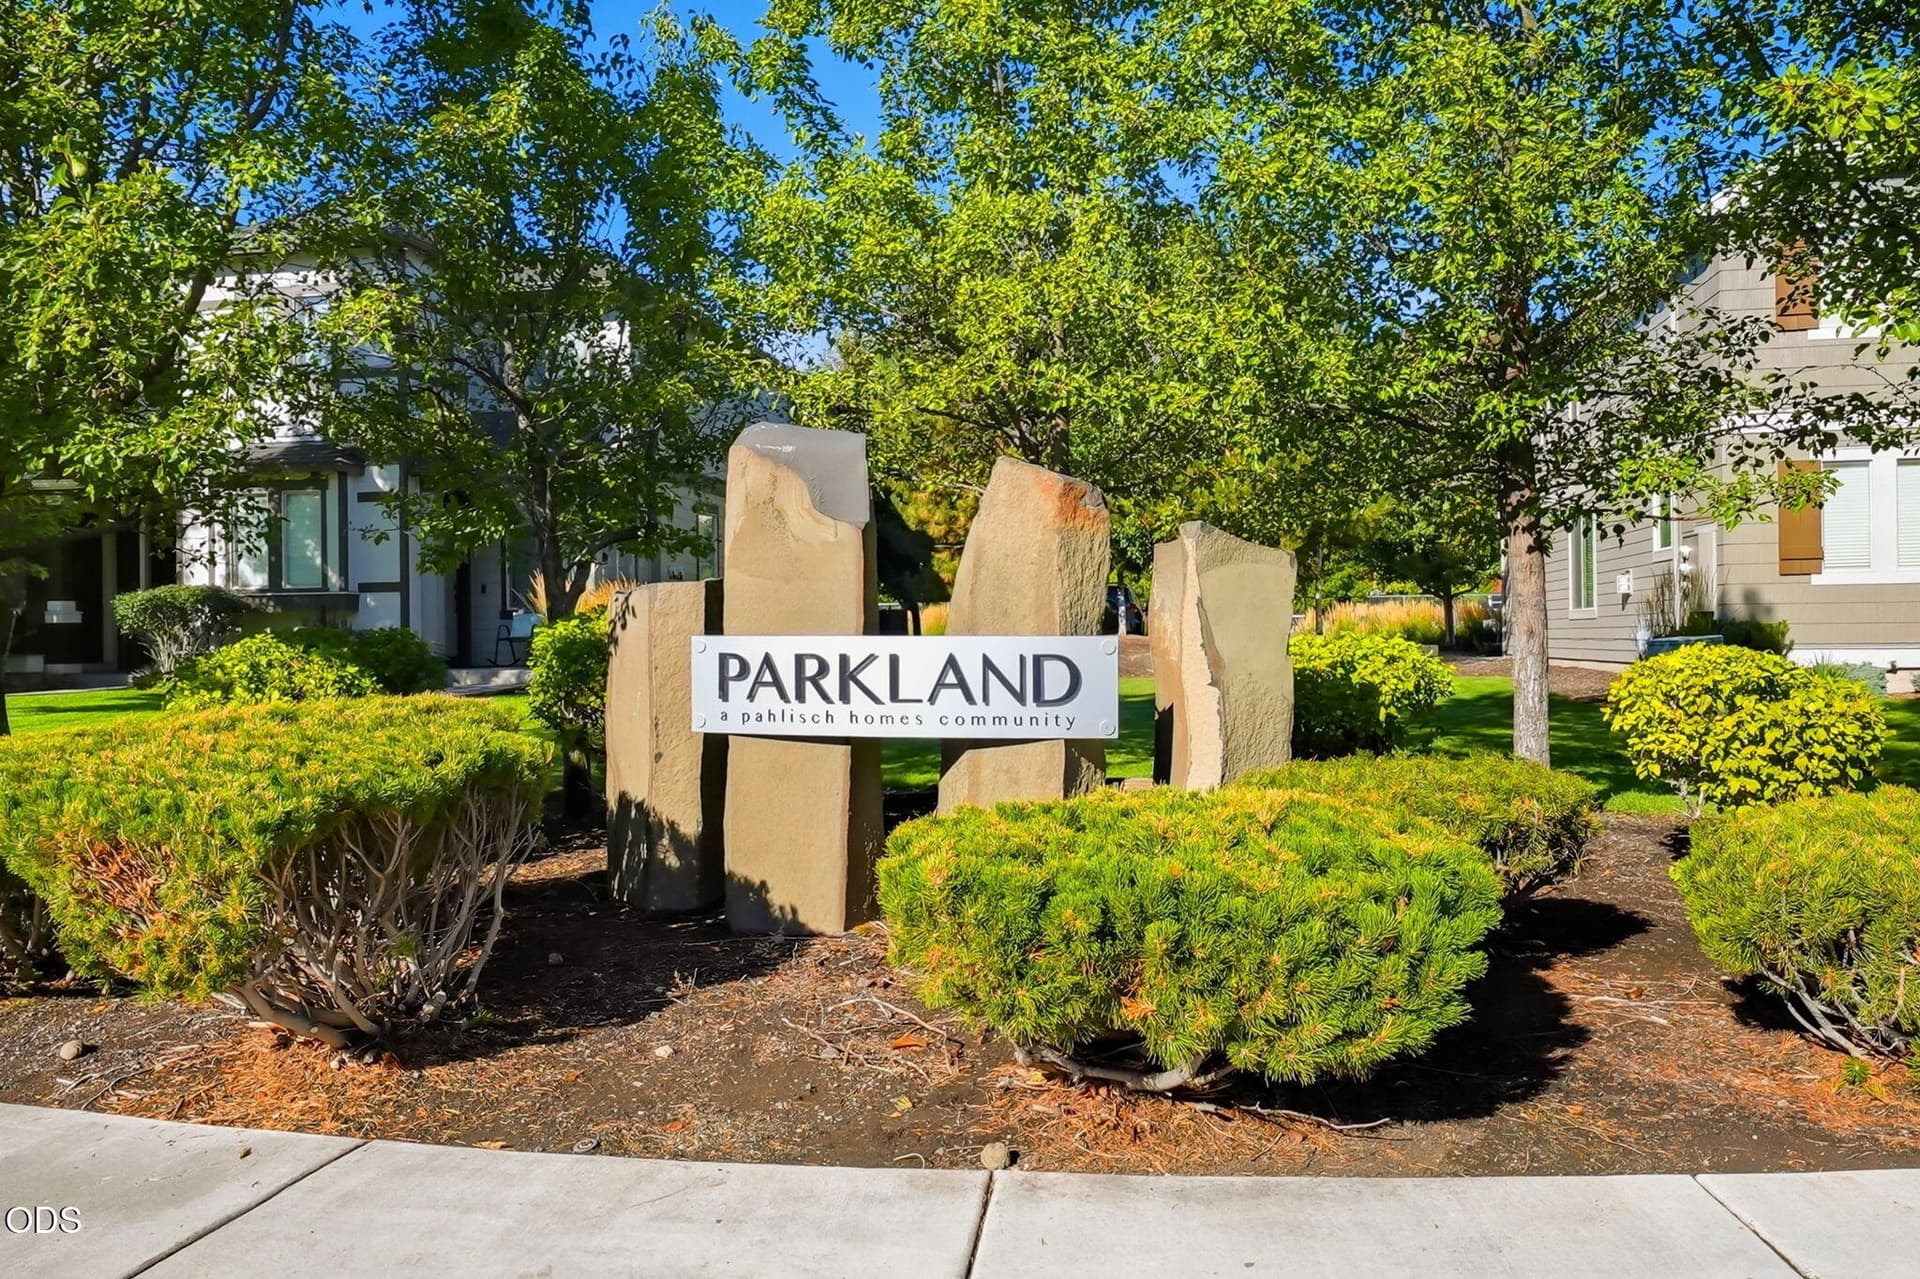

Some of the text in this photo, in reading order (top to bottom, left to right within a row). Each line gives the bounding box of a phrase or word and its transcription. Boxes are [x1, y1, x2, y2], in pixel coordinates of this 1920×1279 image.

[718, 652, 1082, 707] PARKLAND
[720, 709, 1075, 730] a pahlisch homes community
